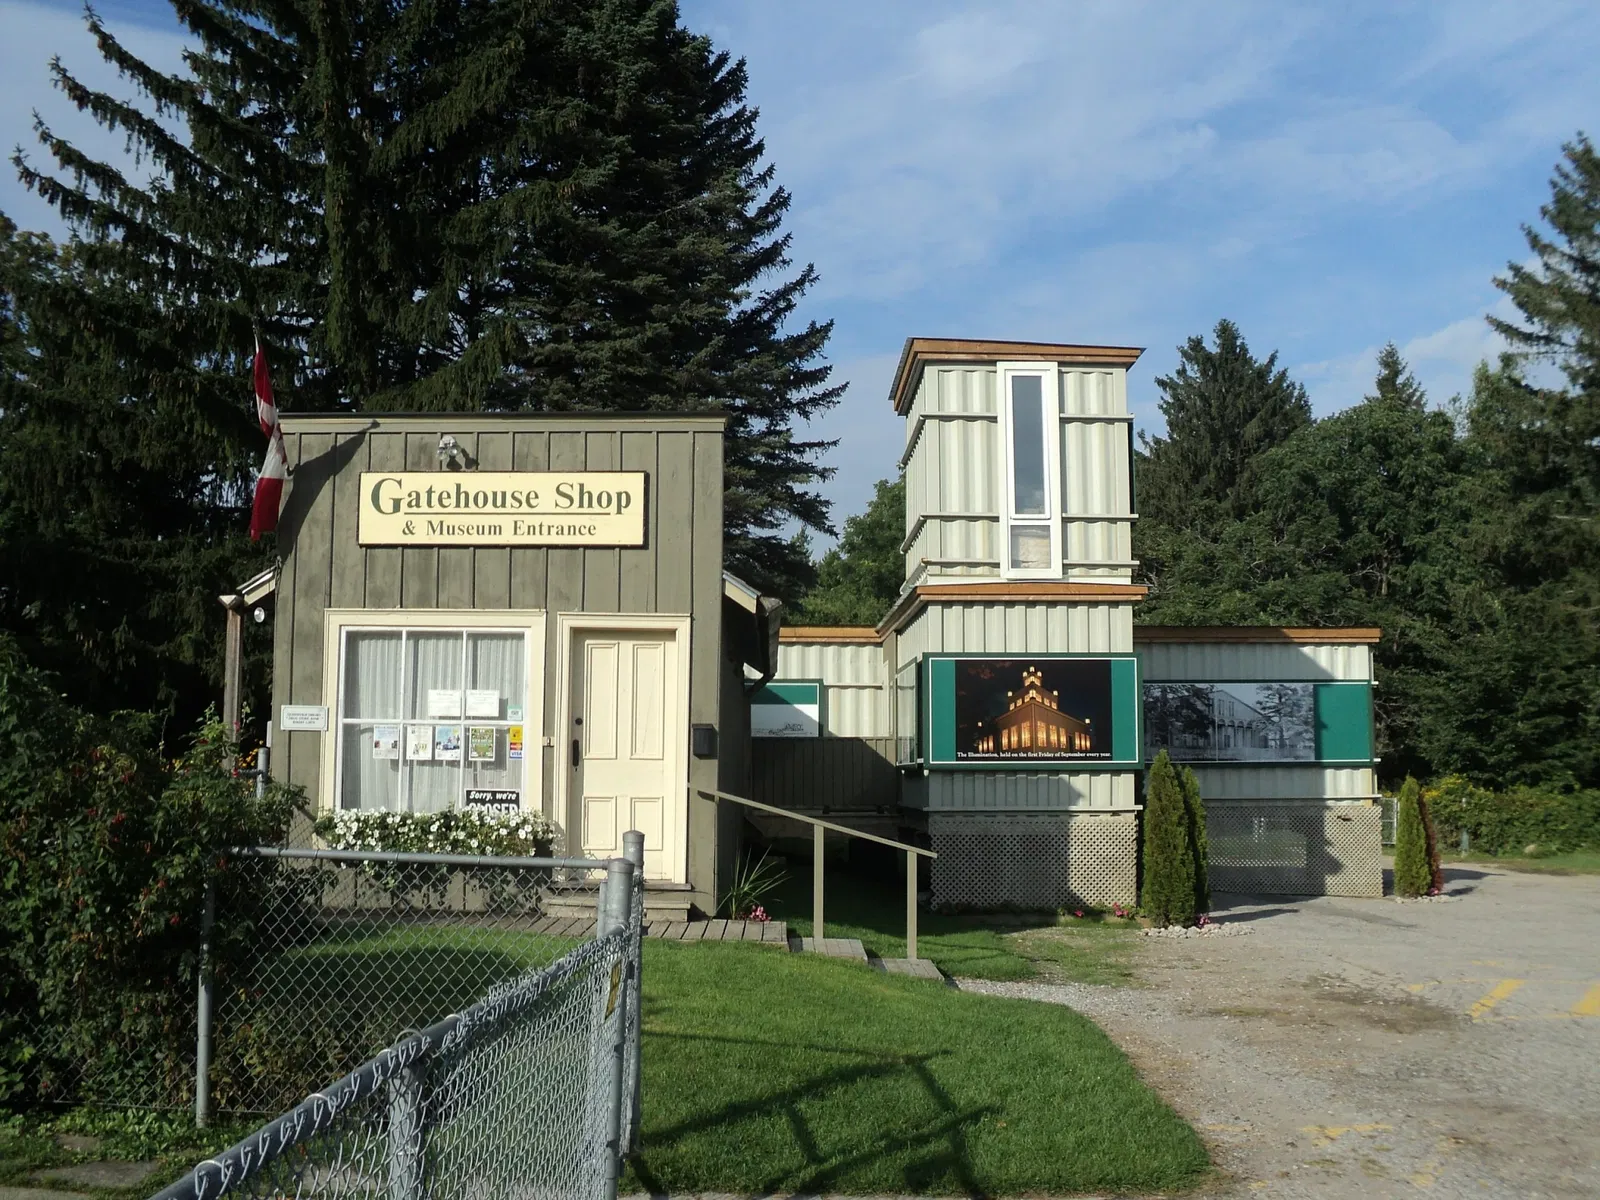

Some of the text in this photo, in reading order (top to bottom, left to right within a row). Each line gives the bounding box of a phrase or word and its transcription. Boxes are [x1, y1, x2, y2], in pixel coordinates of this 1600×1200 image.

[370, 477, 632, 515] Gatehouse Shop
[401, 519, 597, 536] & Museum Entrance
[469, 791, 517, 801] Sorry, we're
[468, 803, 519, 814] OSED
